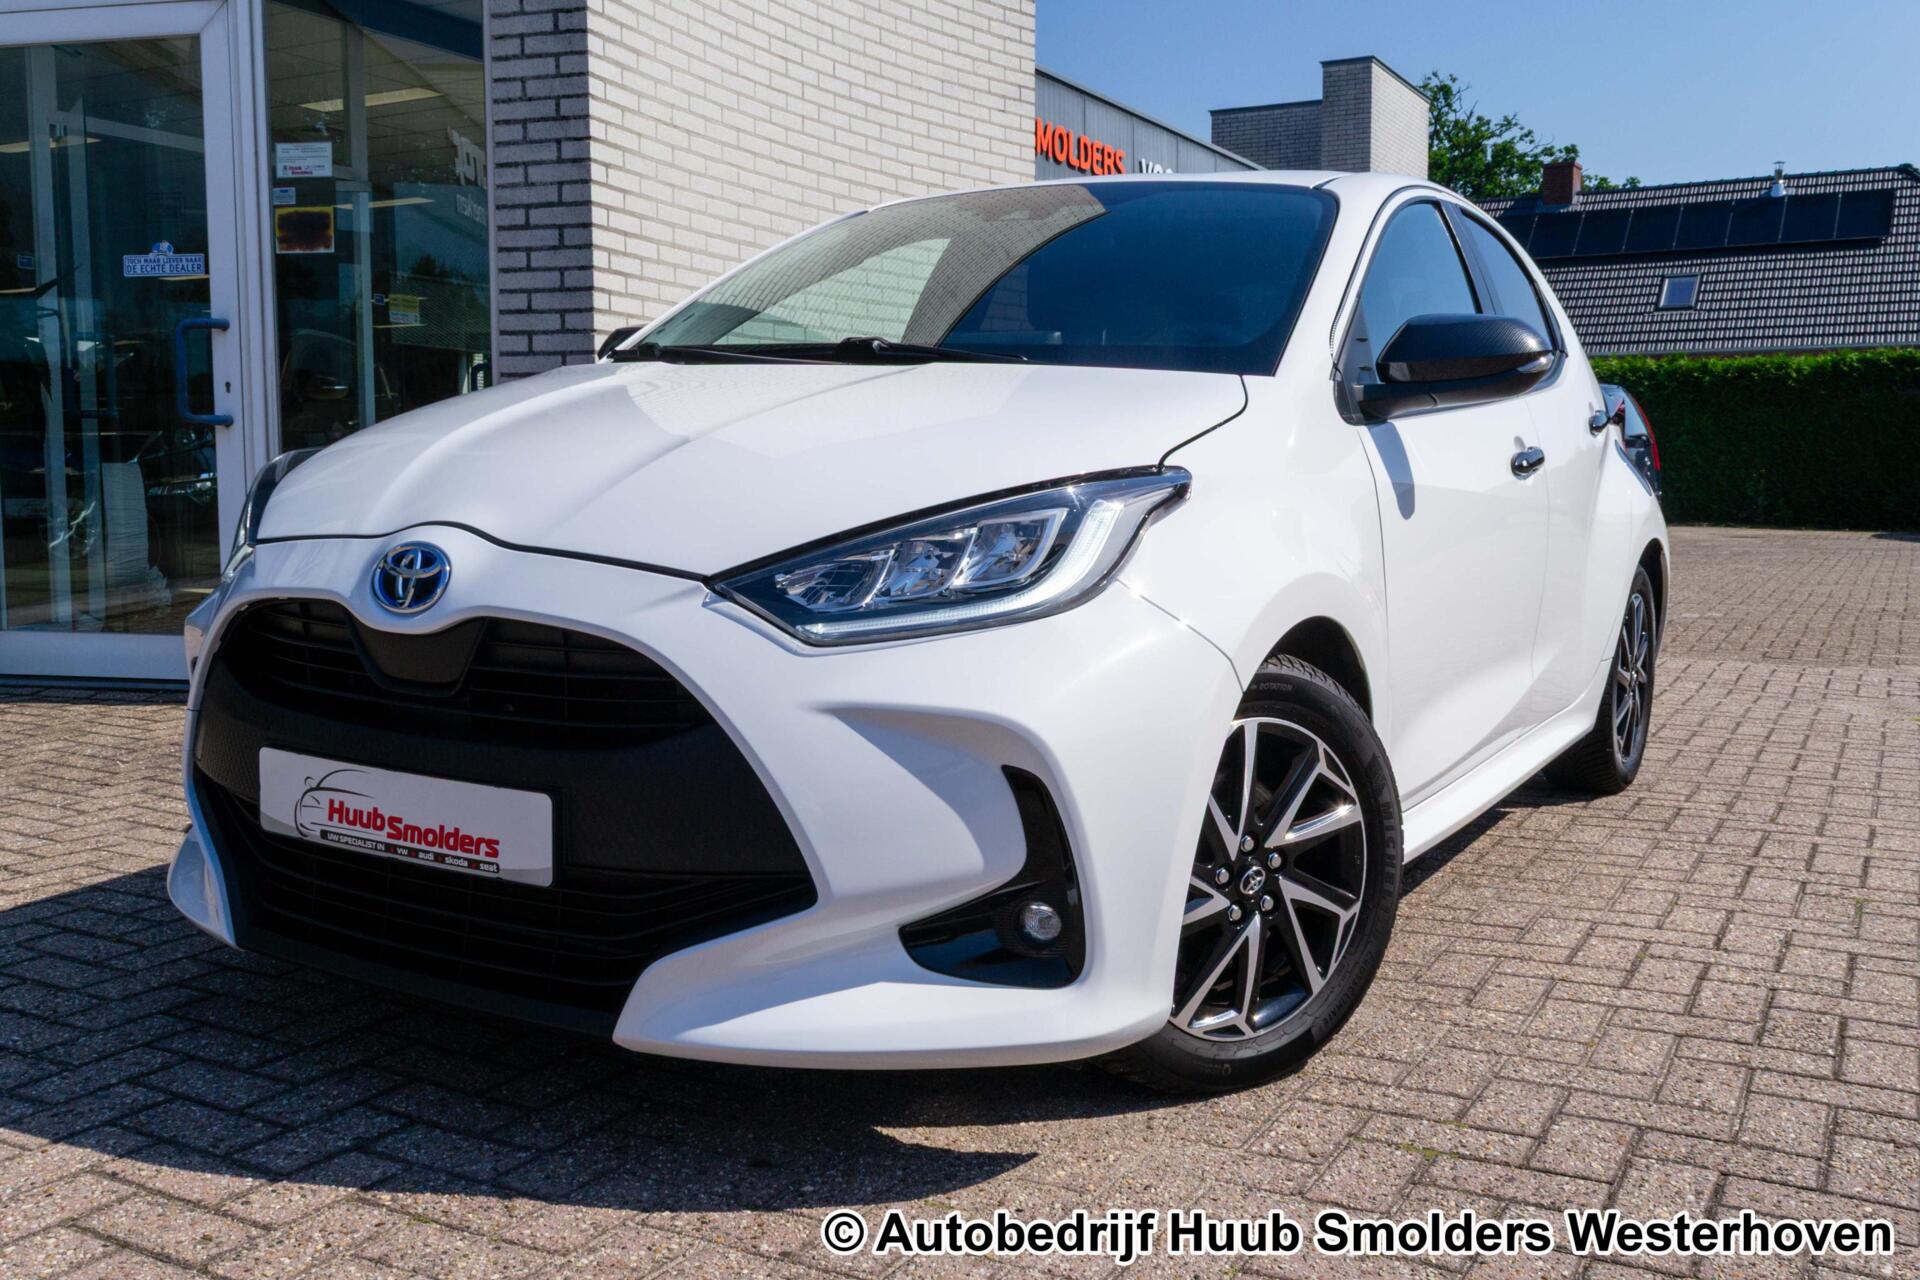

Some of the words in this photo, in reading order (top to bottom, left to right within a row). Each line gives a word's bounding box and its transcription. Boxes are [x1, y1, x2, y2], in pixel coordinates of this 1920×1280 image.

[1036, 117, 1127, 175] MOLDERS
[127, 264, 137, 273] DE
[140, 264, 166, 273] ECHTE
[169, 263, 202, 273] DEALER
[339, 834, 377, 849] SPECIALIST
[377, 843, 385, 851] IN
[418, 851, 434, 861] audi
[445, 856, 468, 867] skoda
[479, 862, 498, 873] seat
